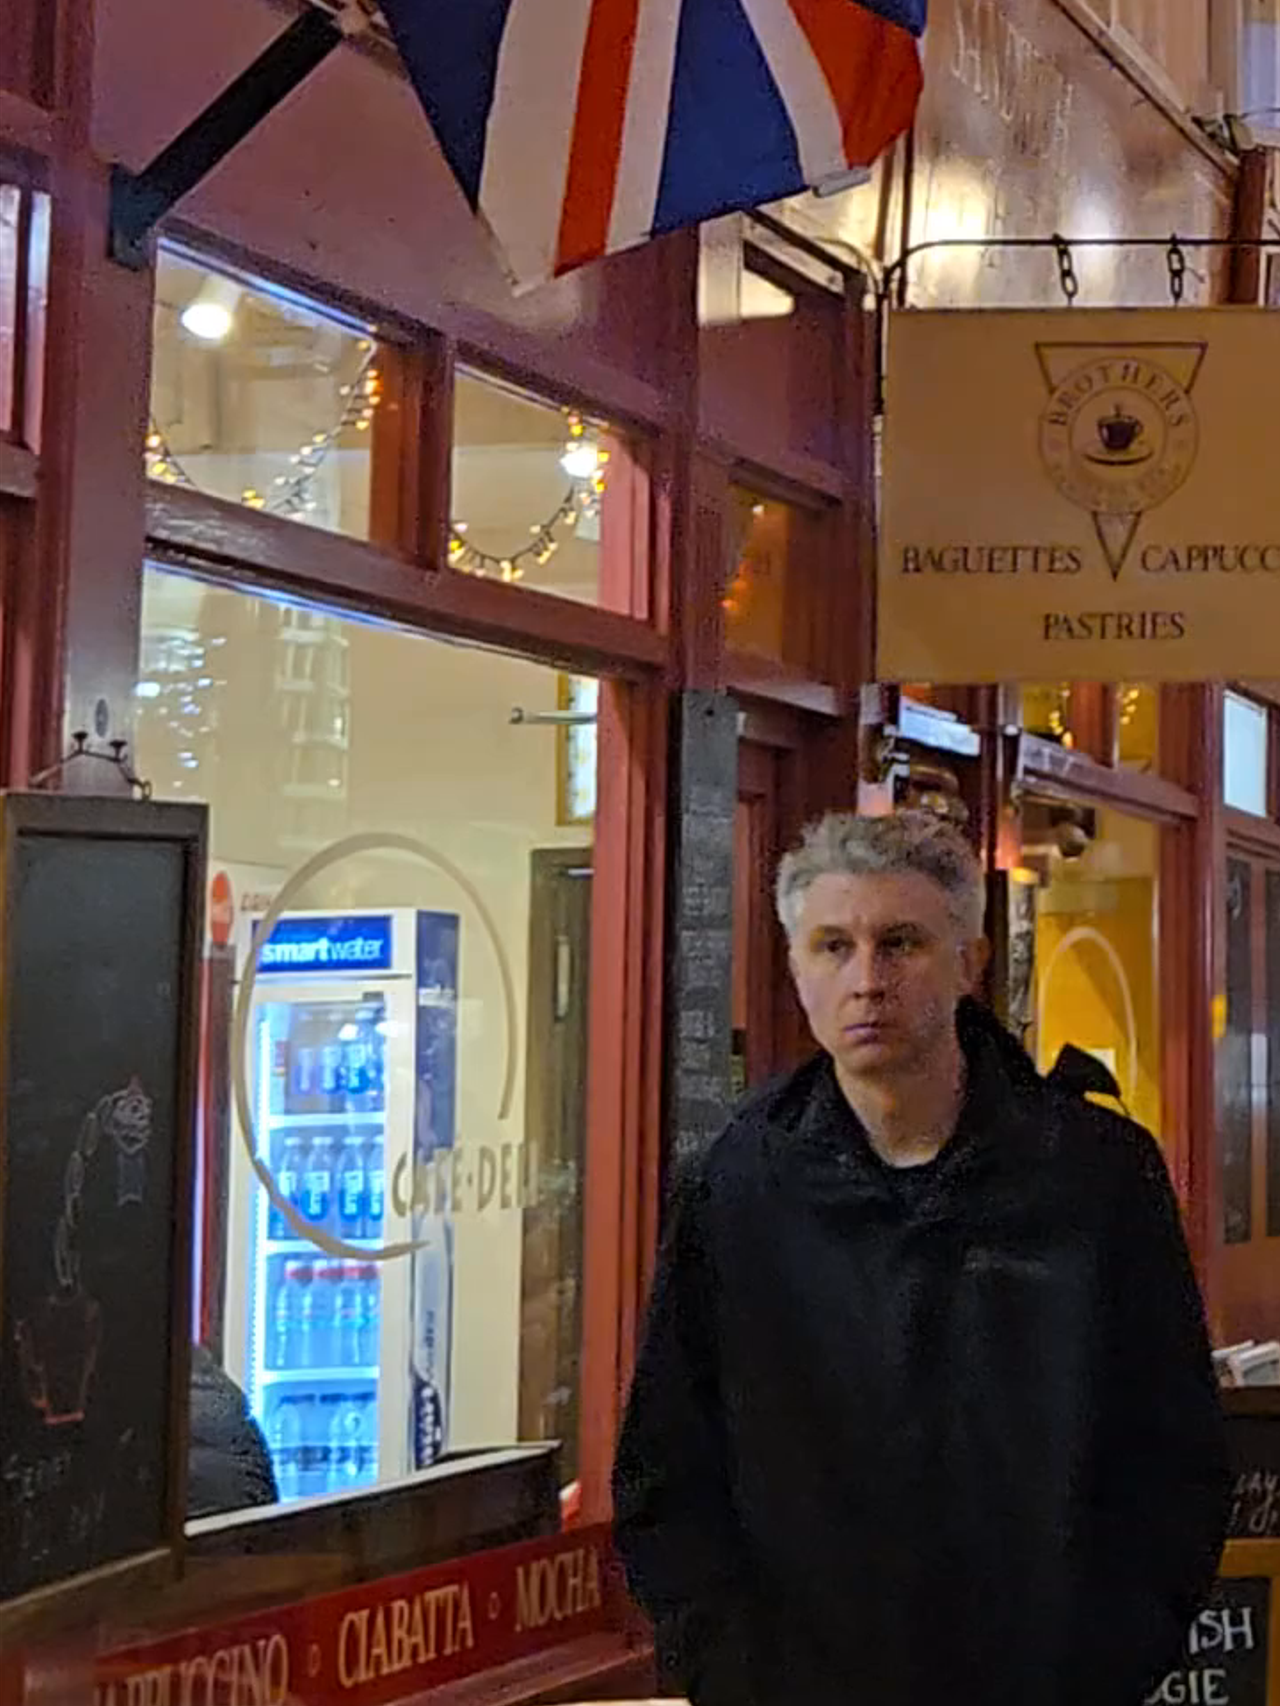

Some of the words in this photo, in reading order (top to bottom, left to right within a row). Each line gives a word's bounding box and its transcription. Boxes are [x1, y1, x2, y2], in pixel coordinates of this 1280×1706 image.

[1048, 363, 1186, 427] BROTHERS
[901, 545, 1083, 574] BAGUETTES
[1042, 611, 1185, 640] PASTRIES
[261, 936, 384, 964] smartwater
[338, 1584, 474, 1687] CIABATTA
[515, 1547, 600, 1632] MOCHA
[1189, 1607, 1254, 1655] ISH
